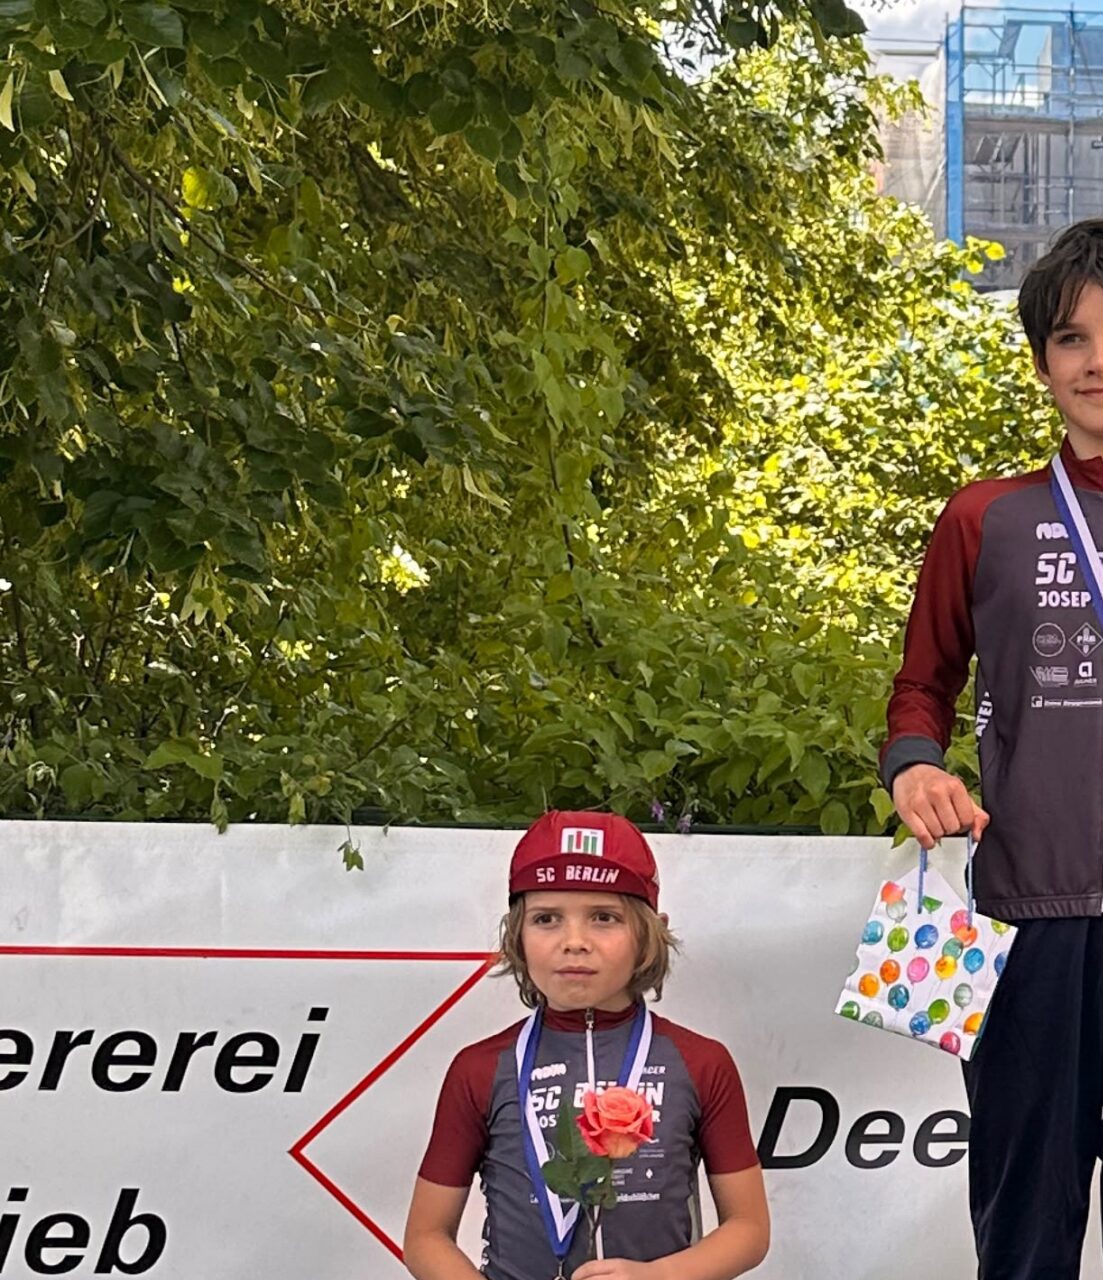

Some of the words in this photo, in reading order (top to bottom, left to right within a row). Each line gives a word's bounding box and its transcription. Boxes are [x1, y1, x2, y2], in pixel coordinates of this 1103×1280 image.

[1035, 552, 1077, 585] SC
[1038, 591, 1092, 607] JOSEP
[536, 867, 555, 883] SC
[565, 865, 620, 884] BERLIN
[0, 1007, 329, 1093] ererei
[0, 1187, 167, 1275] ieb
